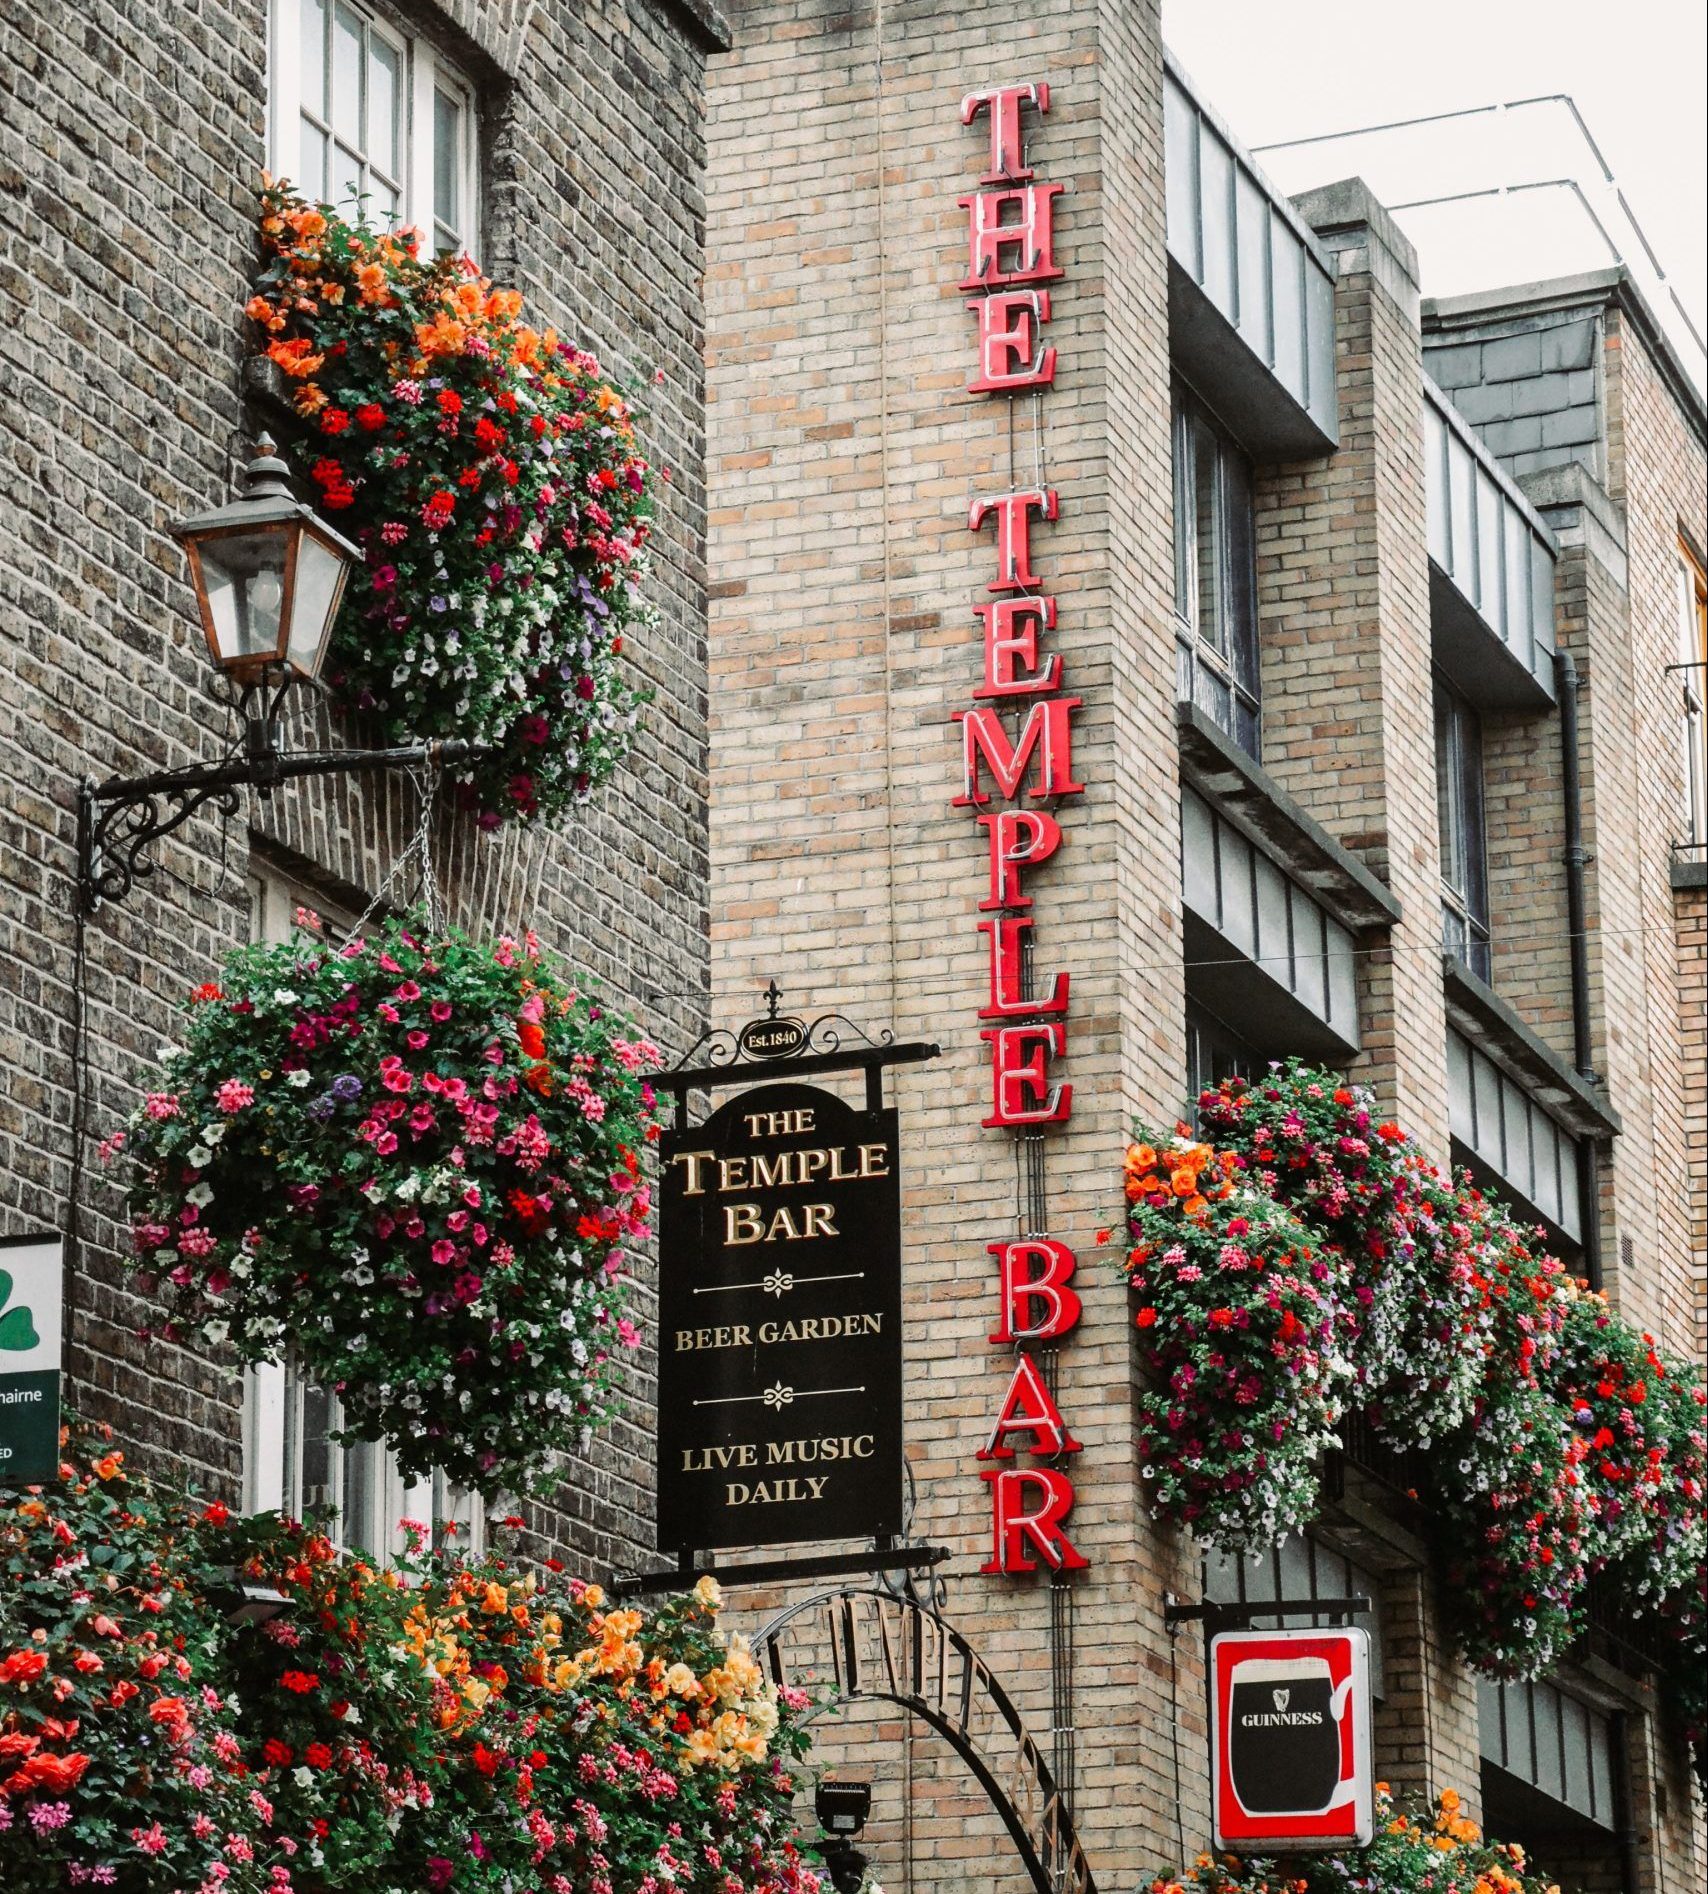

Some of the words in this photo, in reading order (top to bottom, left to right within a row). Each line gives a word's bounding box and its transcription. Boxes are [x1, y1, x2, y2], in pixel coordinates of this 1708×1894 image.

[957, 82, 1065, 394] THE
[951, 489, 1086, 1129] TEMPLE
[744, 1108, 816, 1137] THE
[671, 1143, 890, 1195] TEMPLE
[723, 1203, 840, 1246] BAR
[675, 1325, 753, 1351] BEER
[758, 1313, 884, 1344] GARDEN
[975, 1239, 1091, 1574] BAR
[681, 1444, 758, 1472] LIVE
[765, 1435, 875, 1465] MUSIC
[726, 1476, 829, 1506] DAILY
[1241, 1711, 1323, 1727] GUINNESS
